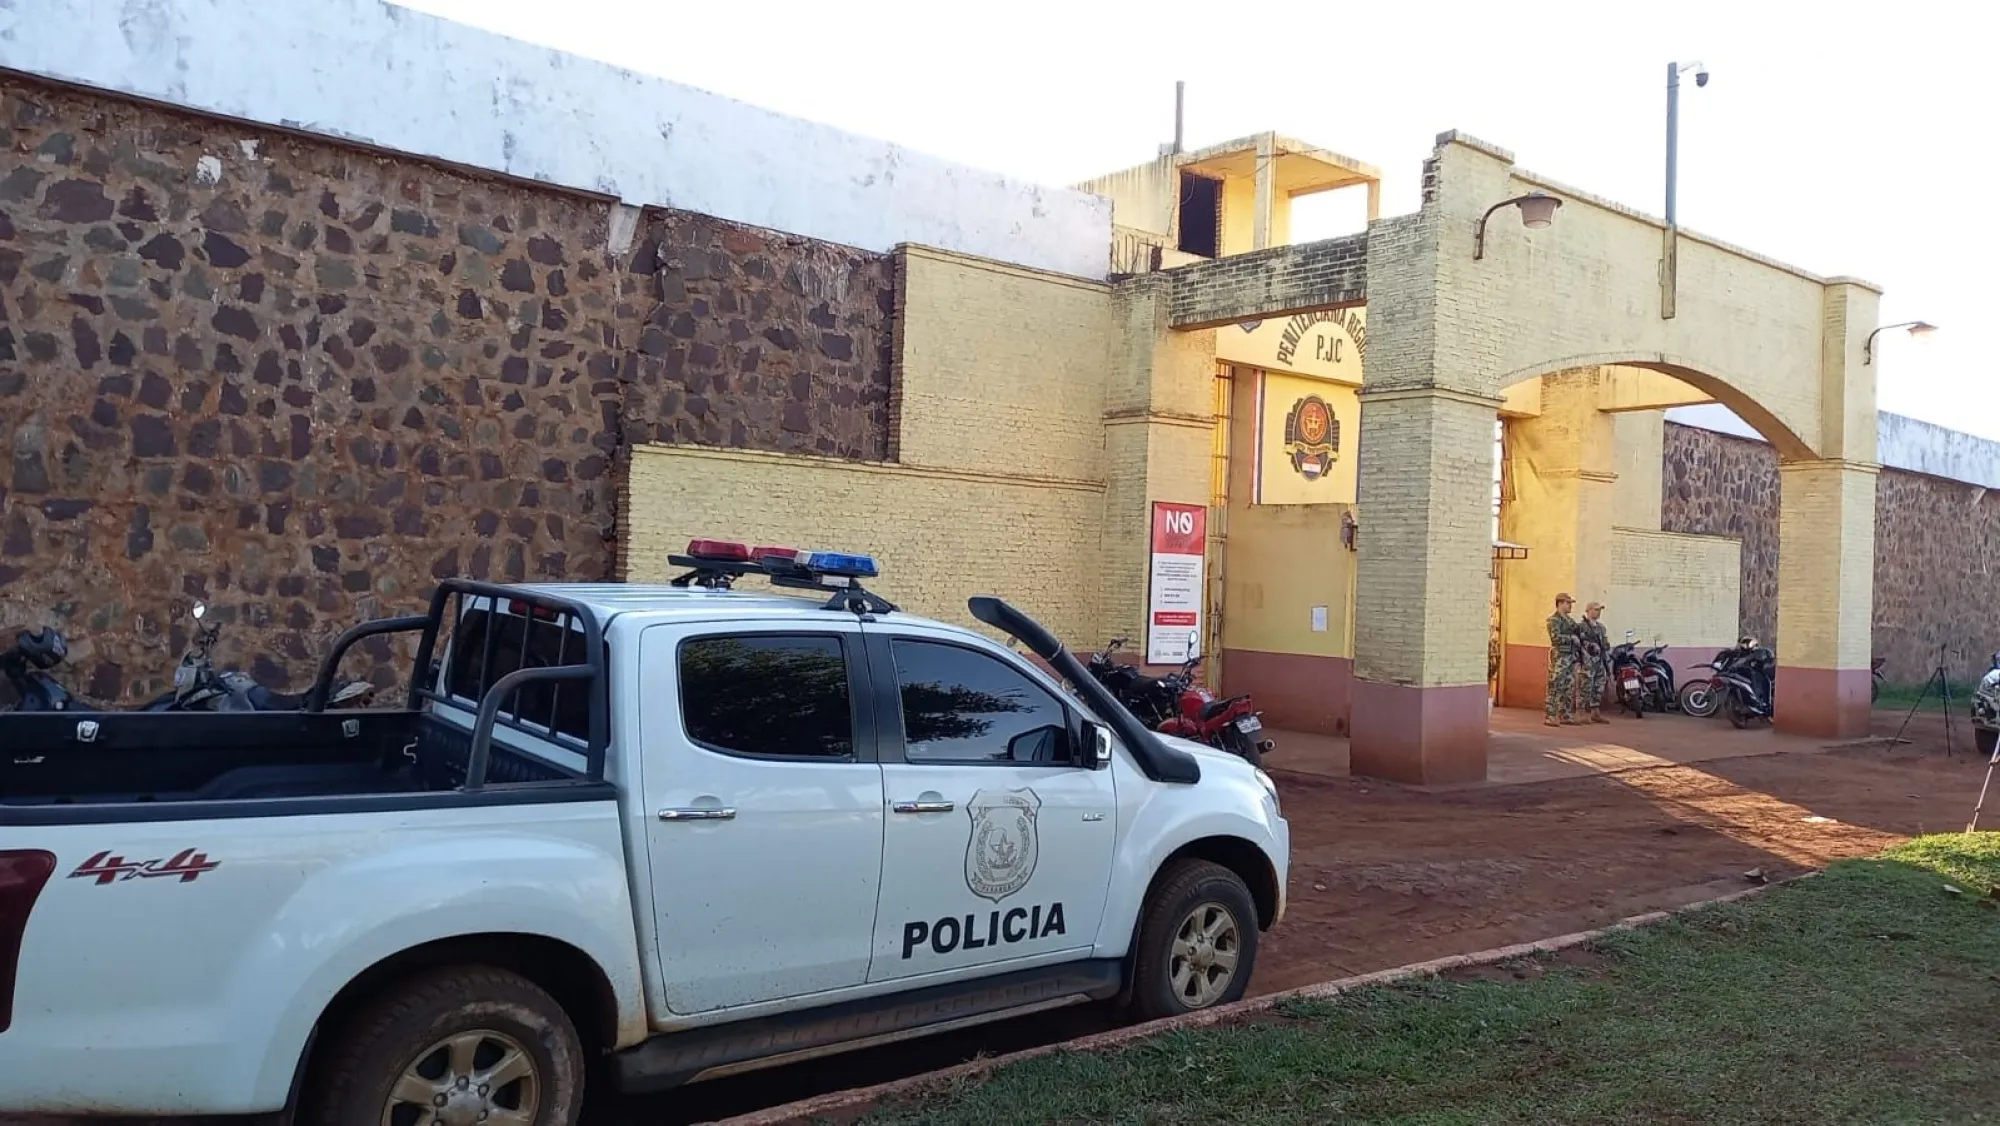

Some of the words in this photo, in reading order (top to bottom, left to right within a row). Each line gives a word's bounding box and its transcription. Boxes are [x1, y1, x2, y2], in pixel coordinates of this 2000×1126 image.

[1346, 312, 1367, 358] REGIO
[1166, 510, 1193, 534] NO
[902, 902, 1066, 959] POLICIA
